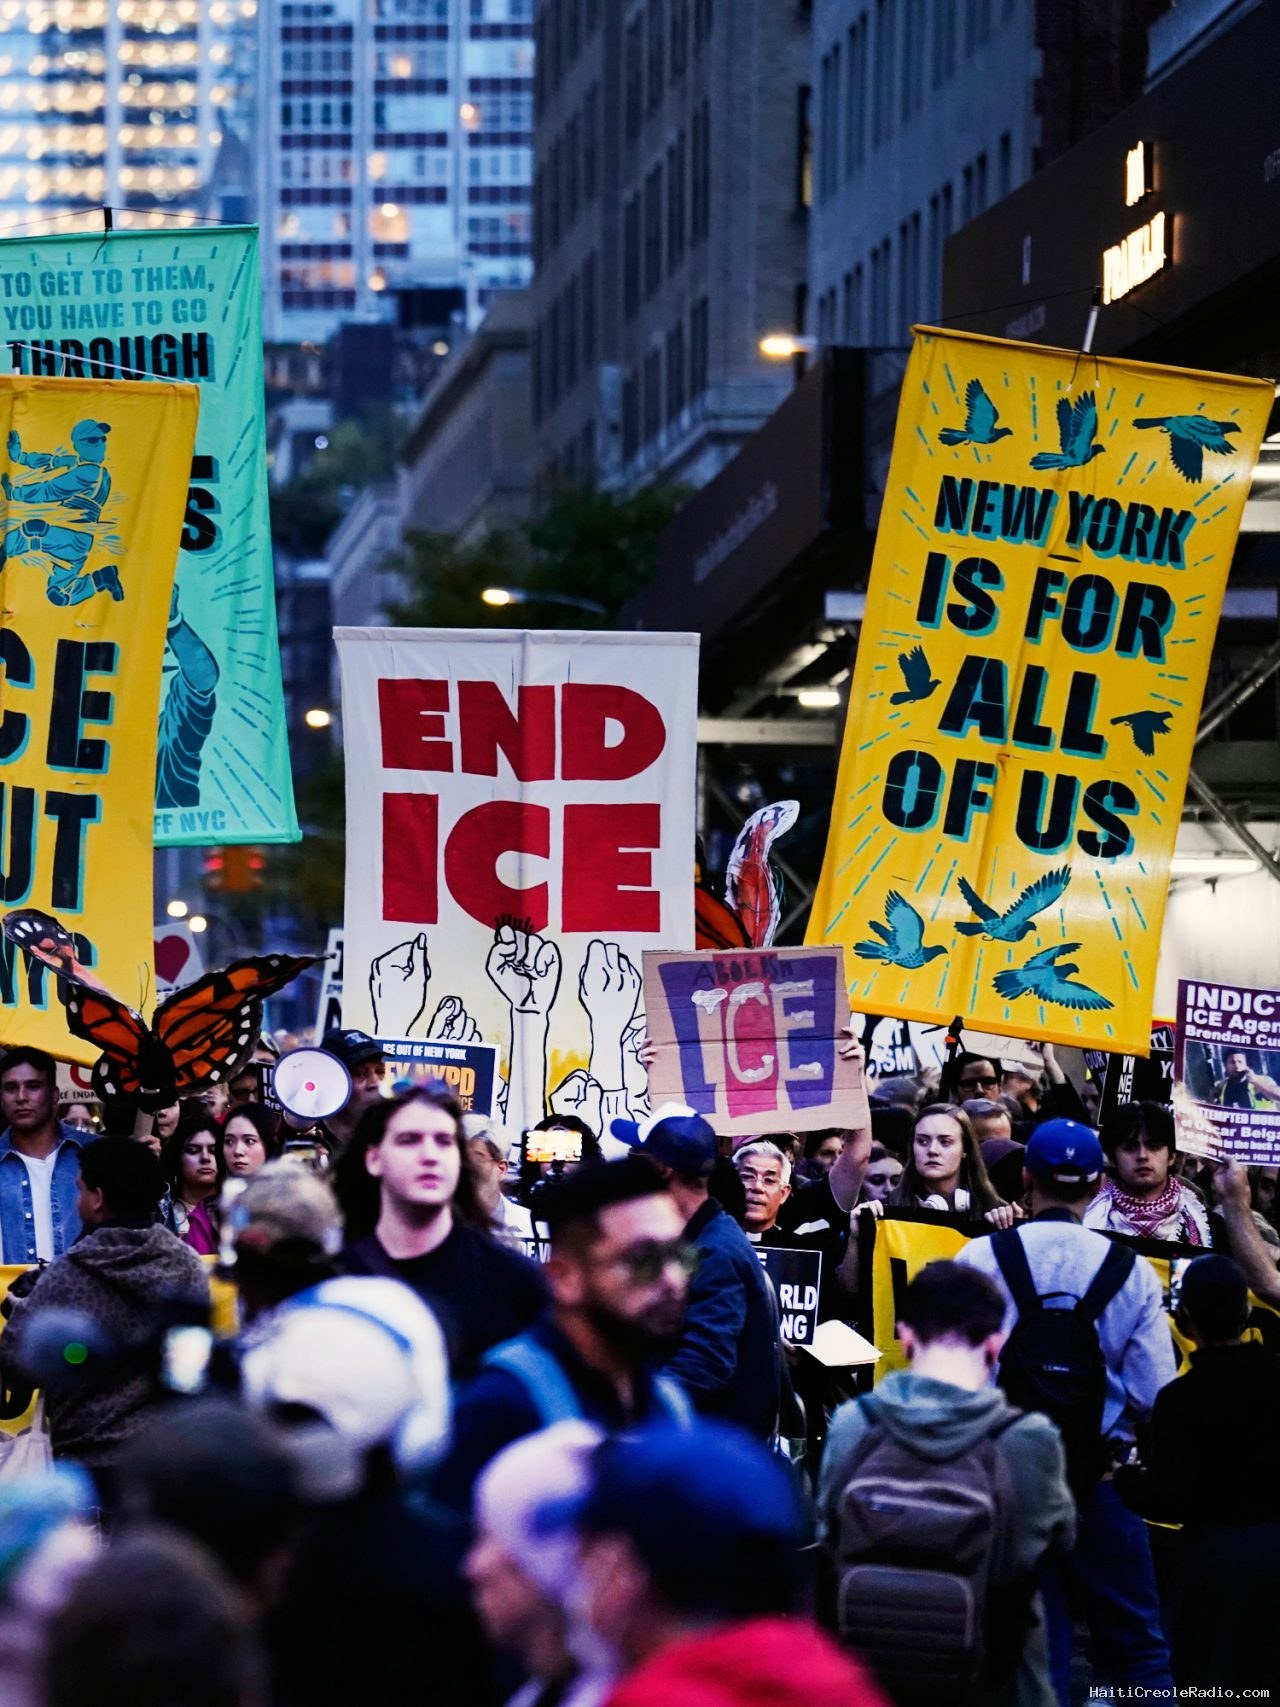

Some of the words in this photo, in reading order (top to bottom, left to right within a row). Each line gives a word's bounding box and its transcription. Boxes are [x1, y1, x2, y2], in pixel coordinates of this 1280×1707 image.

[1, 272, 31, 298] TO
[40, 269, 81, 297] GET
[92, 267, 123, 295] TO
[131, 264, 215, 292] THEM,
[4, 304, 53, 331] YOU
[61, 300, 125, 330] HAVE
[132, 300, 164, 327] TO
[170, 298, 208, 323] GO
[6, 332, 216, 382] THROUGH
[180, 487, 223, 556] S
[934, 474, 1059, 548] NEW
[1066, 490, 1197, 571] YORK
[916, 551, 1006, 637] IS
[1024, 566, 1176, 665] FOR
[937, 654, 1108, 760] ALL
[377, 678, 666, 782] END
[154, 814, 173, 835] FF
[179, 809, 227, 833] NYC
[881, 749, 998, 843] OF
[1014, 768, 1140, 865] US
[382, 791, 661, 934] ICE
[1185, 1007, 1223, 1027] ICE
[1228, 1014, 1280, 1035] Agen
[1186, 985, 1280, 1016] INDIC
[383, 1043, 396, 1055] ICE
[396, 1044, 412, 1056] OUT
[413, 1046, 423, 1057] OF
[424, 1047, 444, 1059] NEW
[445, 1048, 467, 1060] YORK
[691, 978, 825, 1085] ICE
[1185, 1024, 1251, 1045] Brendan
[780, 1283, 818, 1312] RLD
[780, 1314, 808, 1340] NG
